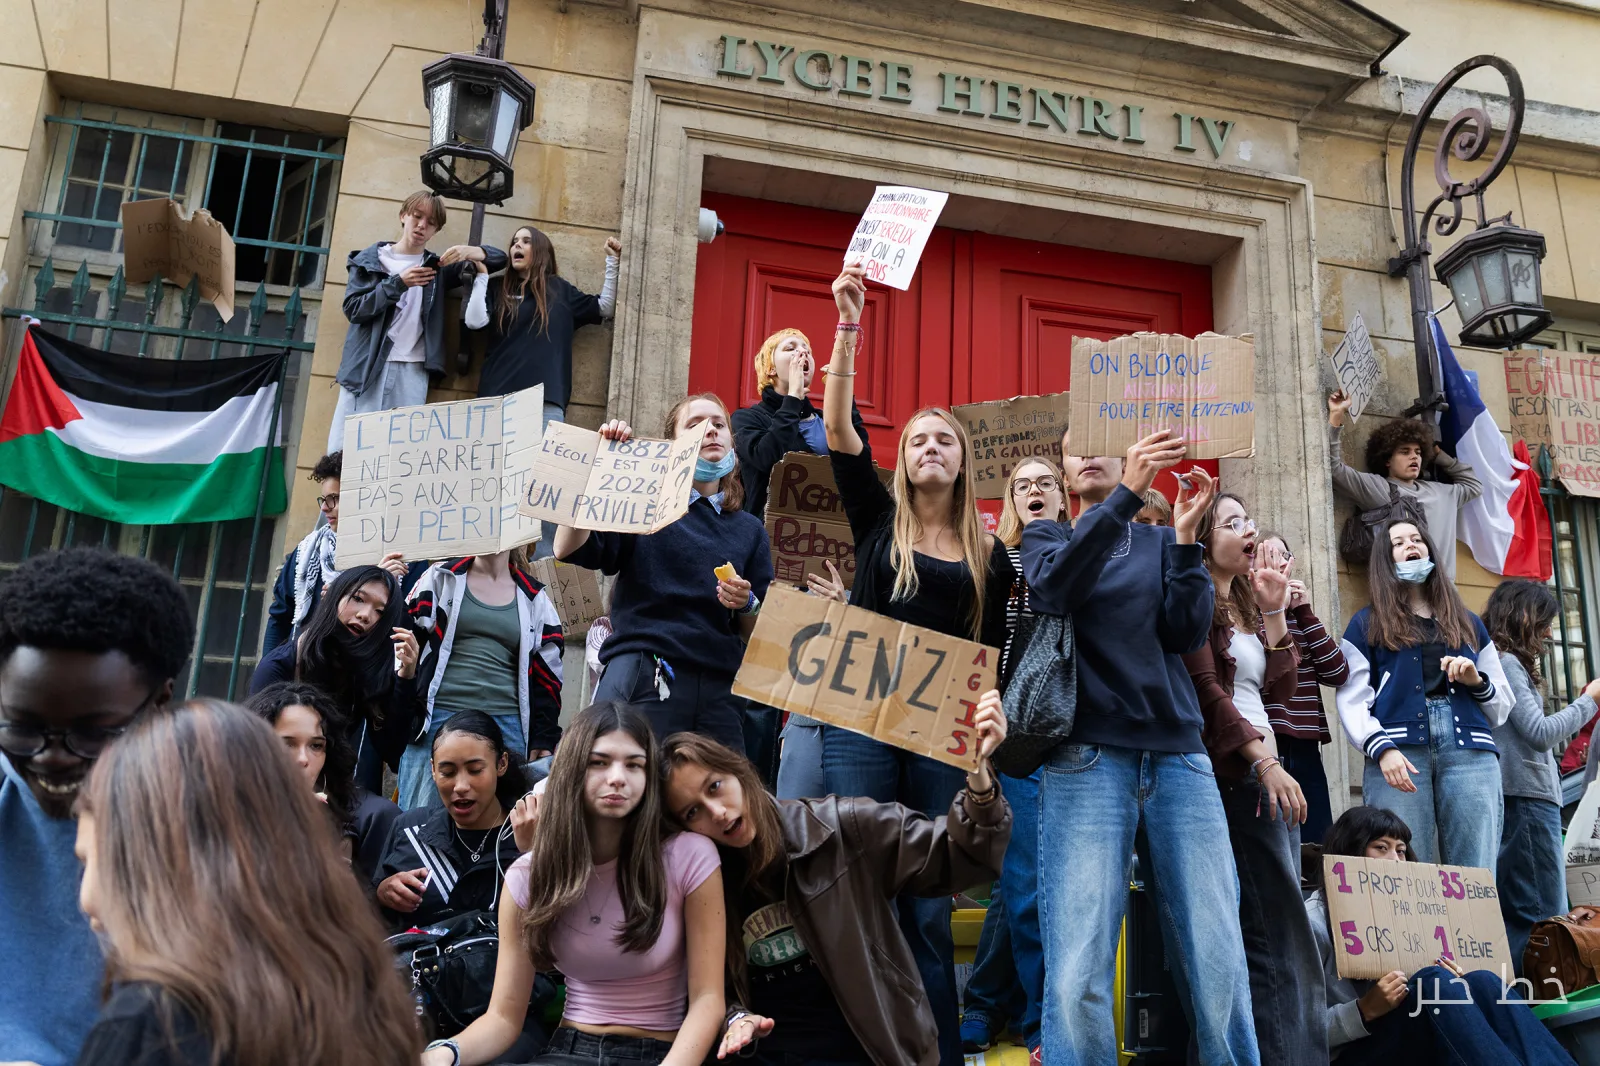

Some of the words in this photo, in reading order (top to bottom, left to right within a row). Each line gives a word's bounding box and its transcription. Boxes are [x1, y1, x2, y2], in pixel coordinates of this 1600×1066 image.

[717, 34, 913, 104] LYCEE
[937, 71, 1145, 145] HENRI
[1173, 112, 1236, 159] IV
[872, 241, 890, 260] ON
[893, 248, 906, 268] A
[1090, 353, 1118, 376] ON
[1129, 351, 1214, 378] BLOQUE
[1099, 402, 1138, 420] POUR
[1190, 401, 1255, 418] ENTENDU
[1525, 397, 1563, 417] SONT
[1567, 400, 1592, 420] PAS
[968, 418, 989, 436] LA
[992, 410, 1055, 431] DROITE
[1561, 421, 1600, 445] LIB
[360, 454, 389, 482] NE
[398, 439, 515, 478] S'ARRÊTE
[542, 440, 604, 467] L'ÉCOLE
[613, 458, 640, 472] EST
[651, 462, 669, 475] UN
[671, 438, 702, 471] DROIT
[607, 439, 670, 459] 1882
[973, 448, 996, 460] LA
[1000, 441, 1061, 459] GAUCHE
[974, 465, 995, 482] ES
[358, 483, 404, 510] PAS
[414, 480, 458, 507] AUX
[528, 479, 563, 511] UN
[571, 493, 671, 525] PRIVILÈGE
[674, 466, 691, 509] ?
[361, 514, 401, 543] DU
[1332, 861, 1353, 894] 1
[1358, 870, 1401, 896] PROF
[1406, 875, 1437, 899] POUR
[1438, 870, 1466, 900] 35
[1464, 876, 1498, 900] ÉLÈVES
[1393, 900, 1411, 917] PAR
[1416, 901, 1447, 916] CONTRE
[1340, 920, 1365, 956] 5
[1366, 926, 1394, 953] CRS
[1403, 929, 1426, 954] SUR
[1433, 925, 1455, 961] 1
[1455, 927, 1494, 960] ÉLÈVE
